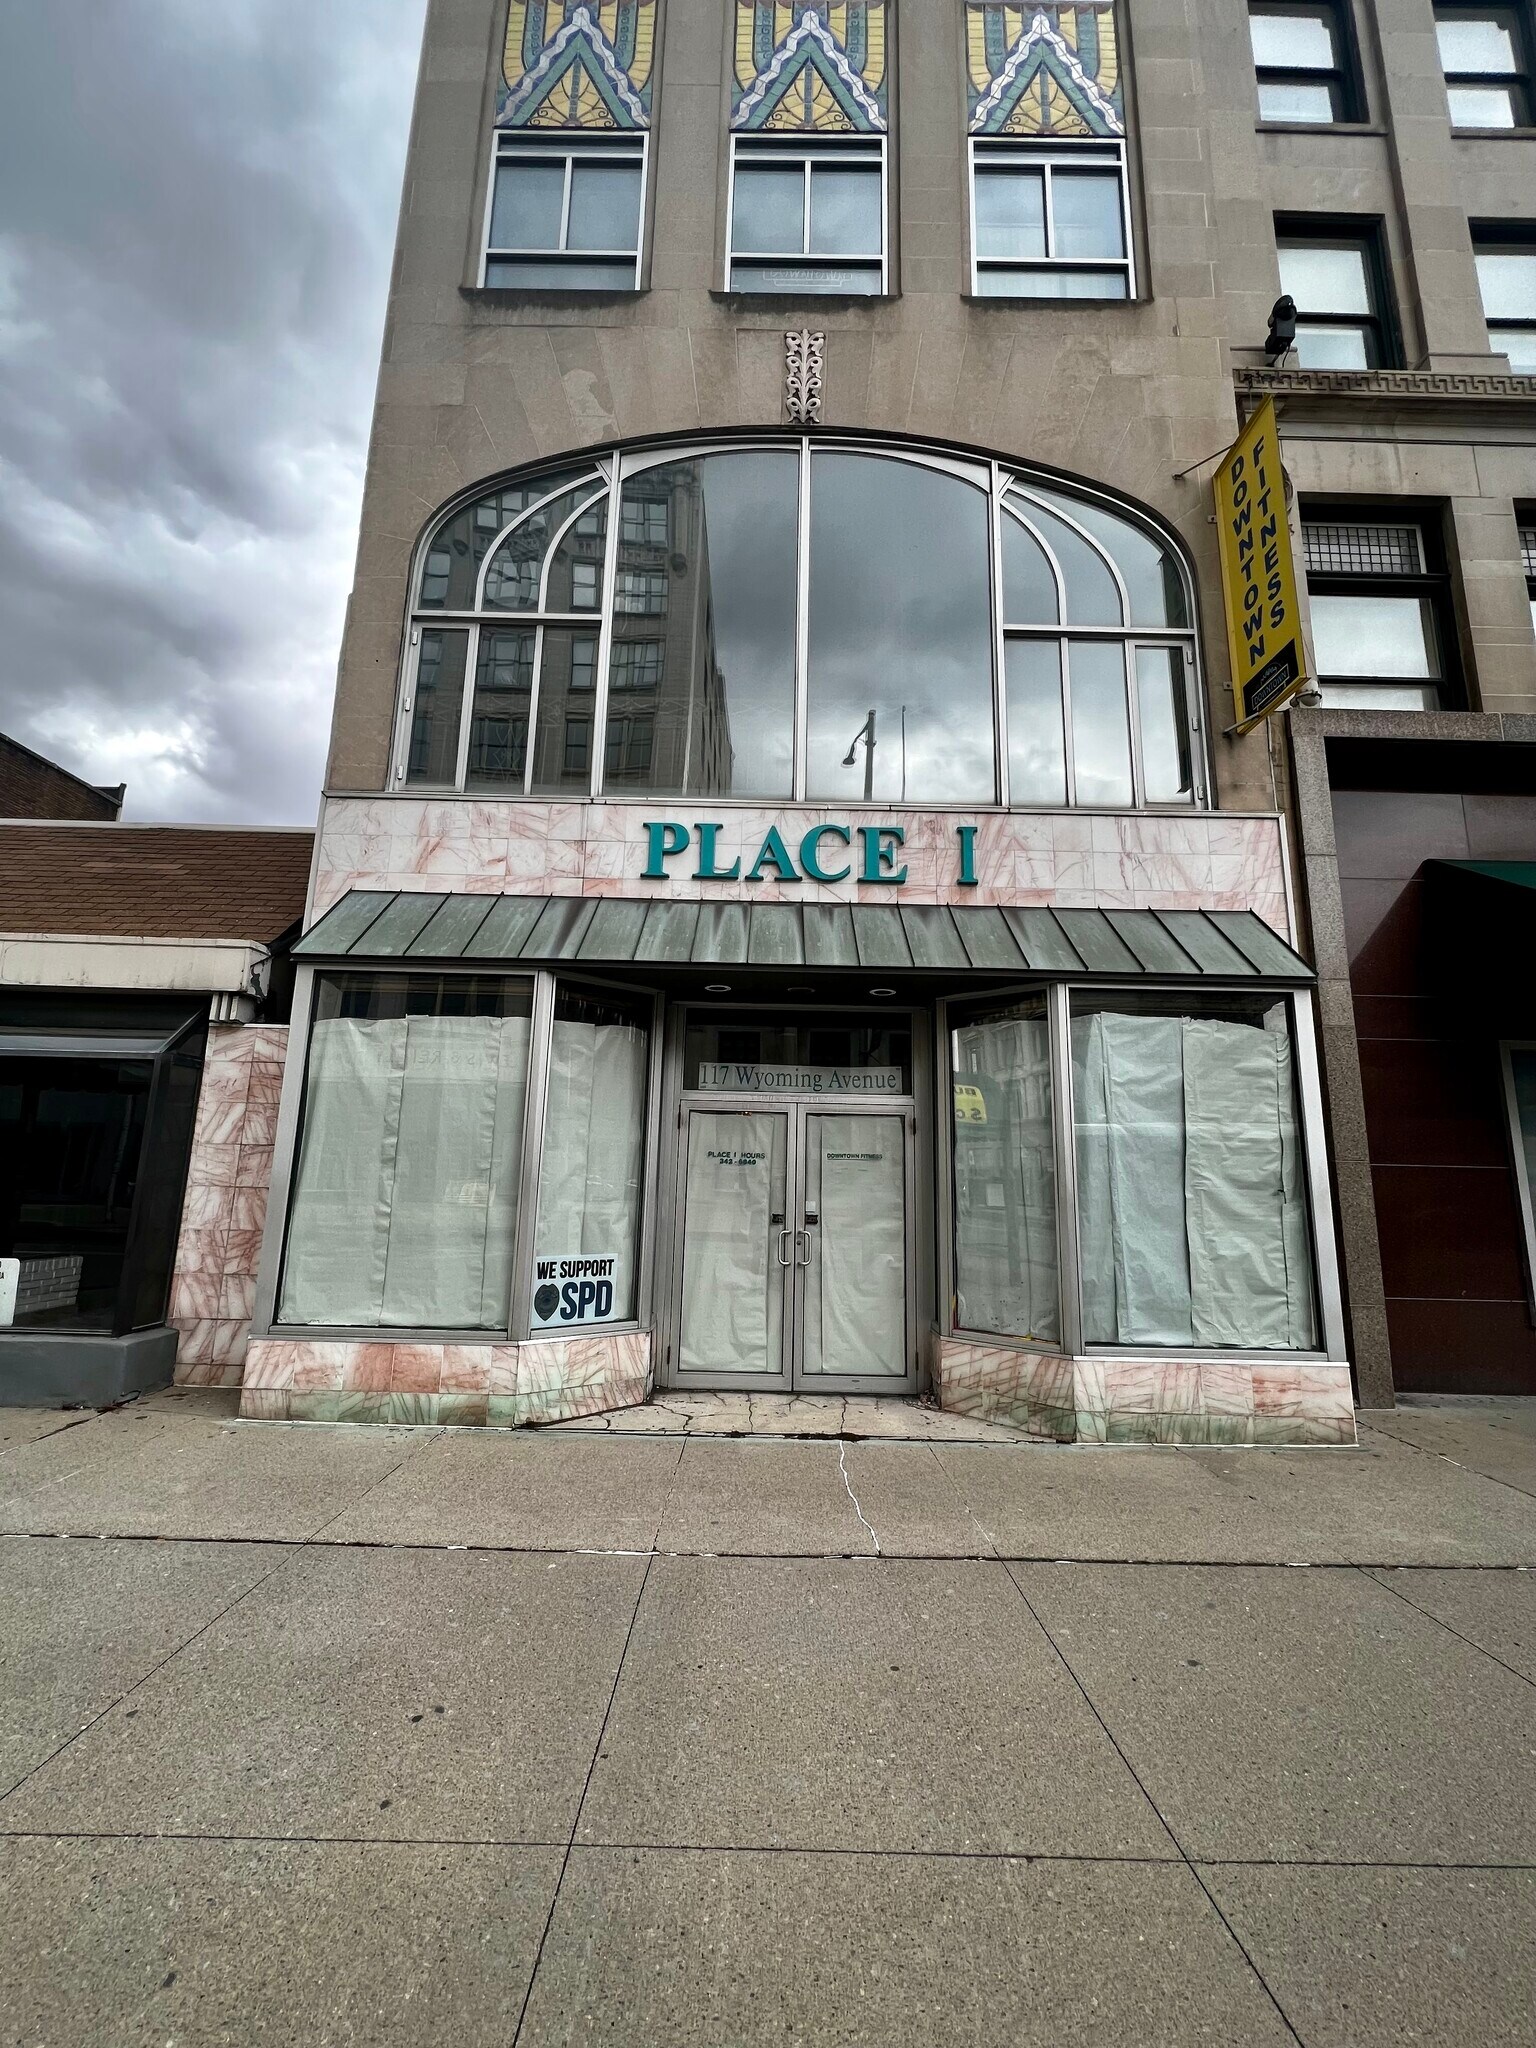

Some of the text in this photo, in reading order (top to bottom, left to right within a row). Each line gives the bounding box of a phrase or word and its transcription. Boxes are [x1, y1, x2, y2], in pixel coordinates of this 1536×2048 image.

[1253, 435, 1285, 630] FITNESS
[1231, 455, 1265, 668] DOWNTOWN
[640, 822, 908, 884] PLACE
[701, 1065, 897, 1091] 117 Wyoming Avenue
[537, 1259, 615, 1280] WE SUPPORT
[559, 1280, 613, 1321] SPD
